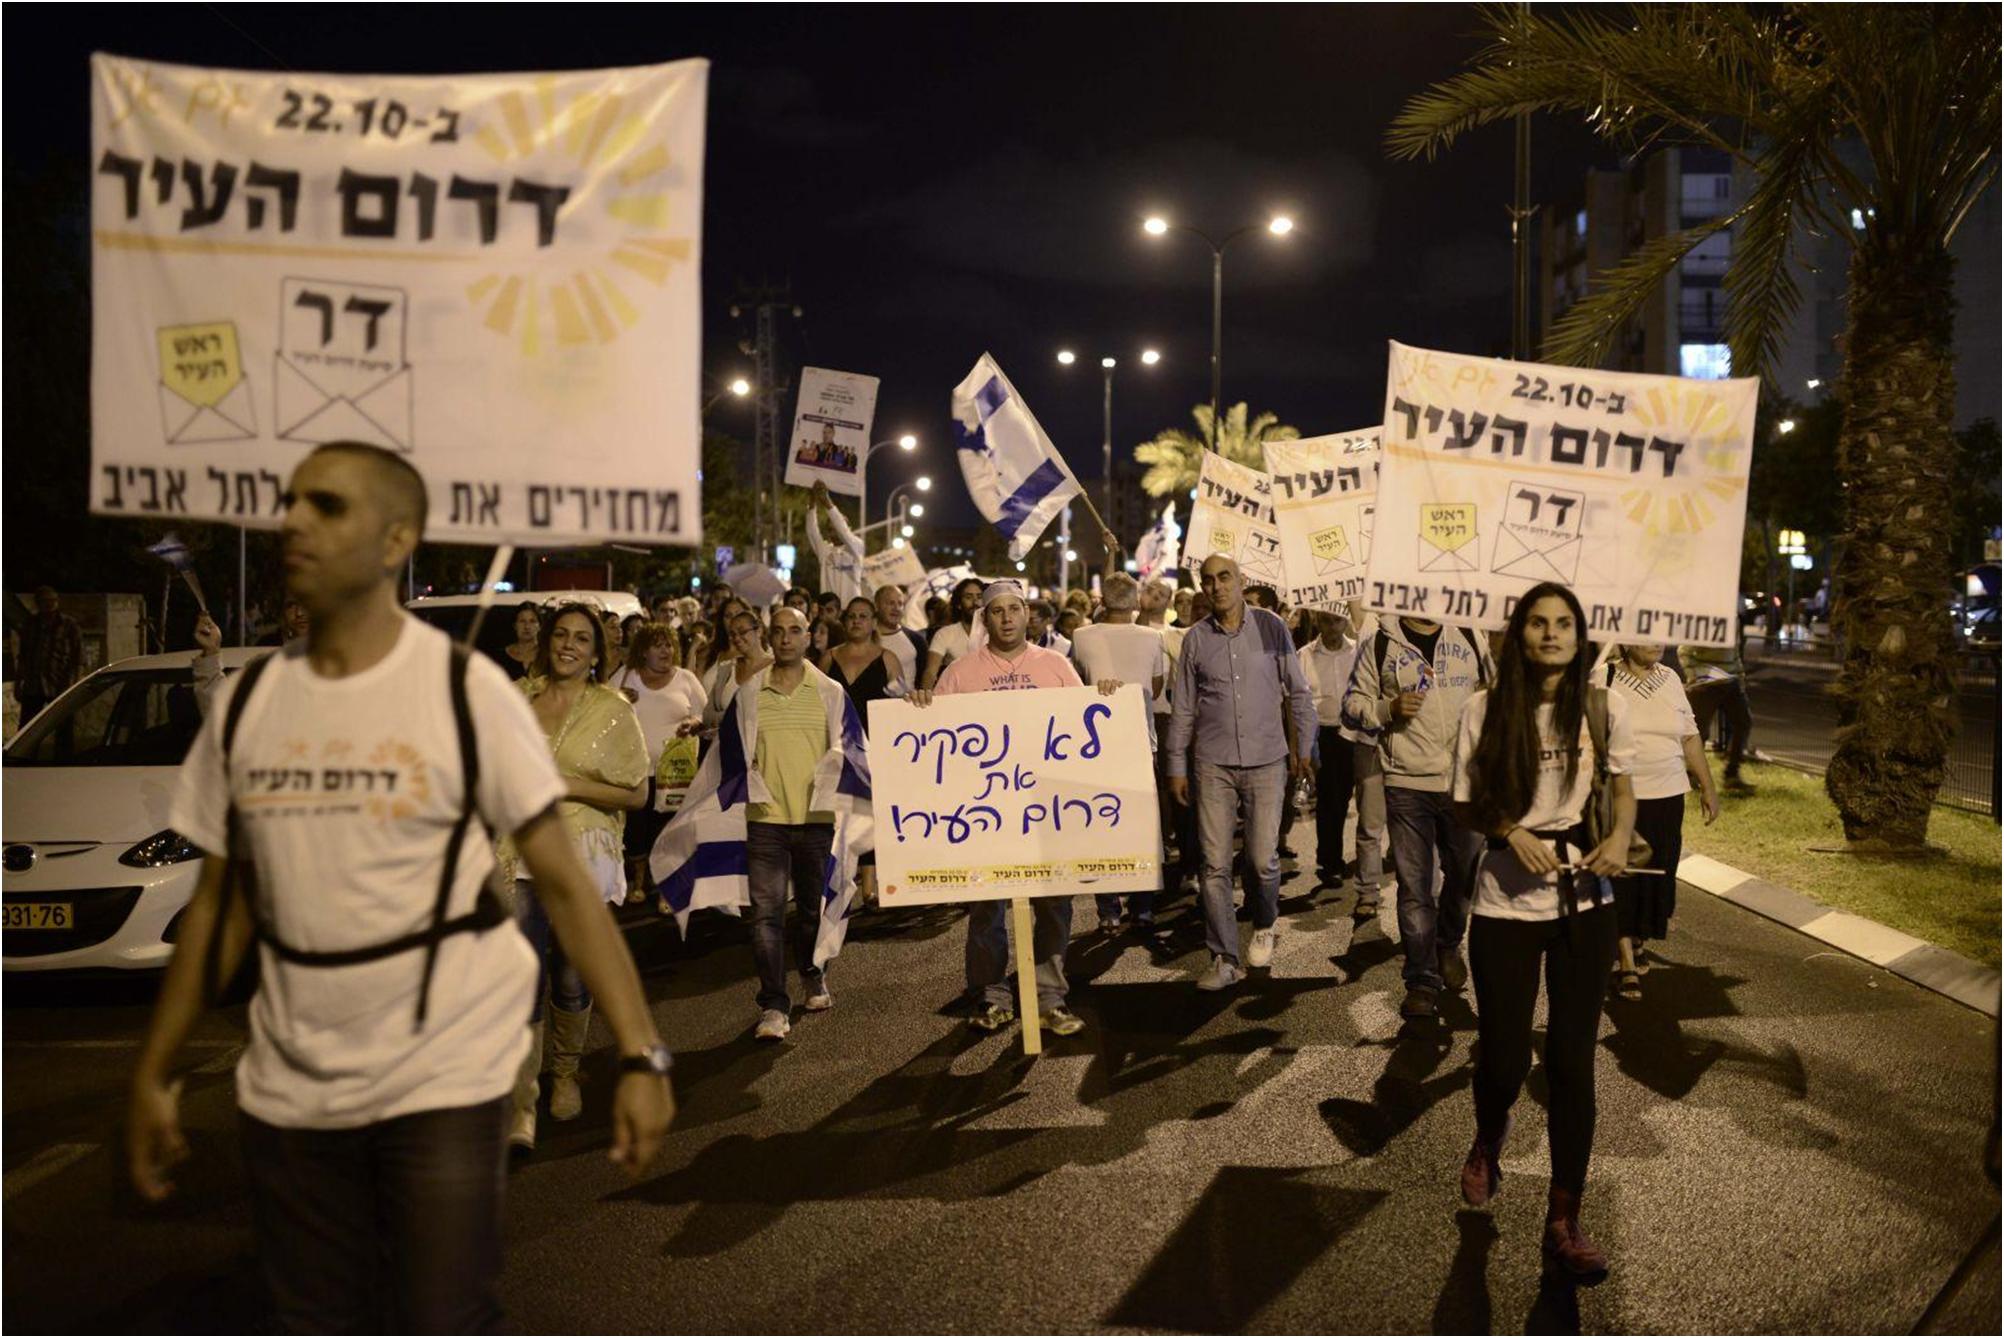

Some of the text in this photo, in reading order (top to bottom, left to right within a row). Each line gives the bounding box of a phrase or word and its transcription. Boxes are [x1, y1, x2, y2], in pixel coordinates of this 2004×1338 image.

[99, 149, 571, 249] דרום העיר
[294, 289, 393, 354] דר
[173, 332, 222, 356] ראש
[174, 358, 228, 382] העיר
[1511, 372, 1627, 415] ב-22.10
[1392, 396, 1685, 479] דרום העיר
[103, 464, 285, 516] לתל אביב
[1201, 476, 1261, 518] העיר
[1272, 466, 1362, 499] העיר
[449, 481, 681, 534] מחזירים את
[1430, 509, 1465, 521] ראש
[1515, 488, 1578, 528] דר
[1252, 531, 1280, 553] דר
[1315, 530, 1338, 544] ראש
[1316, 539, 1341, 552] העיר
[1429, 524, 1467, 538] העיר
[1291, 576, 1365, 606] לתל אביב
[1371, 581, 1429, 612] אביב
[1441, 587, 1489, 619] לתל
[1588, 604, 1728, 643] מחזירים את
[989, 672, 1032, 686] WHAT IS
[892, 703, 1113, 785] לא נפקיר
[322, 768, 399, 792] דרום
[973, 763, 1037, 800] את
[890, 792, 1122, 844] דרום העיר!
[907, 874, 967, 885] דרום העיר
[992, 869, 1052, 879] דרום העיר
[1077, 862, 1136, 873] דרום העיר
